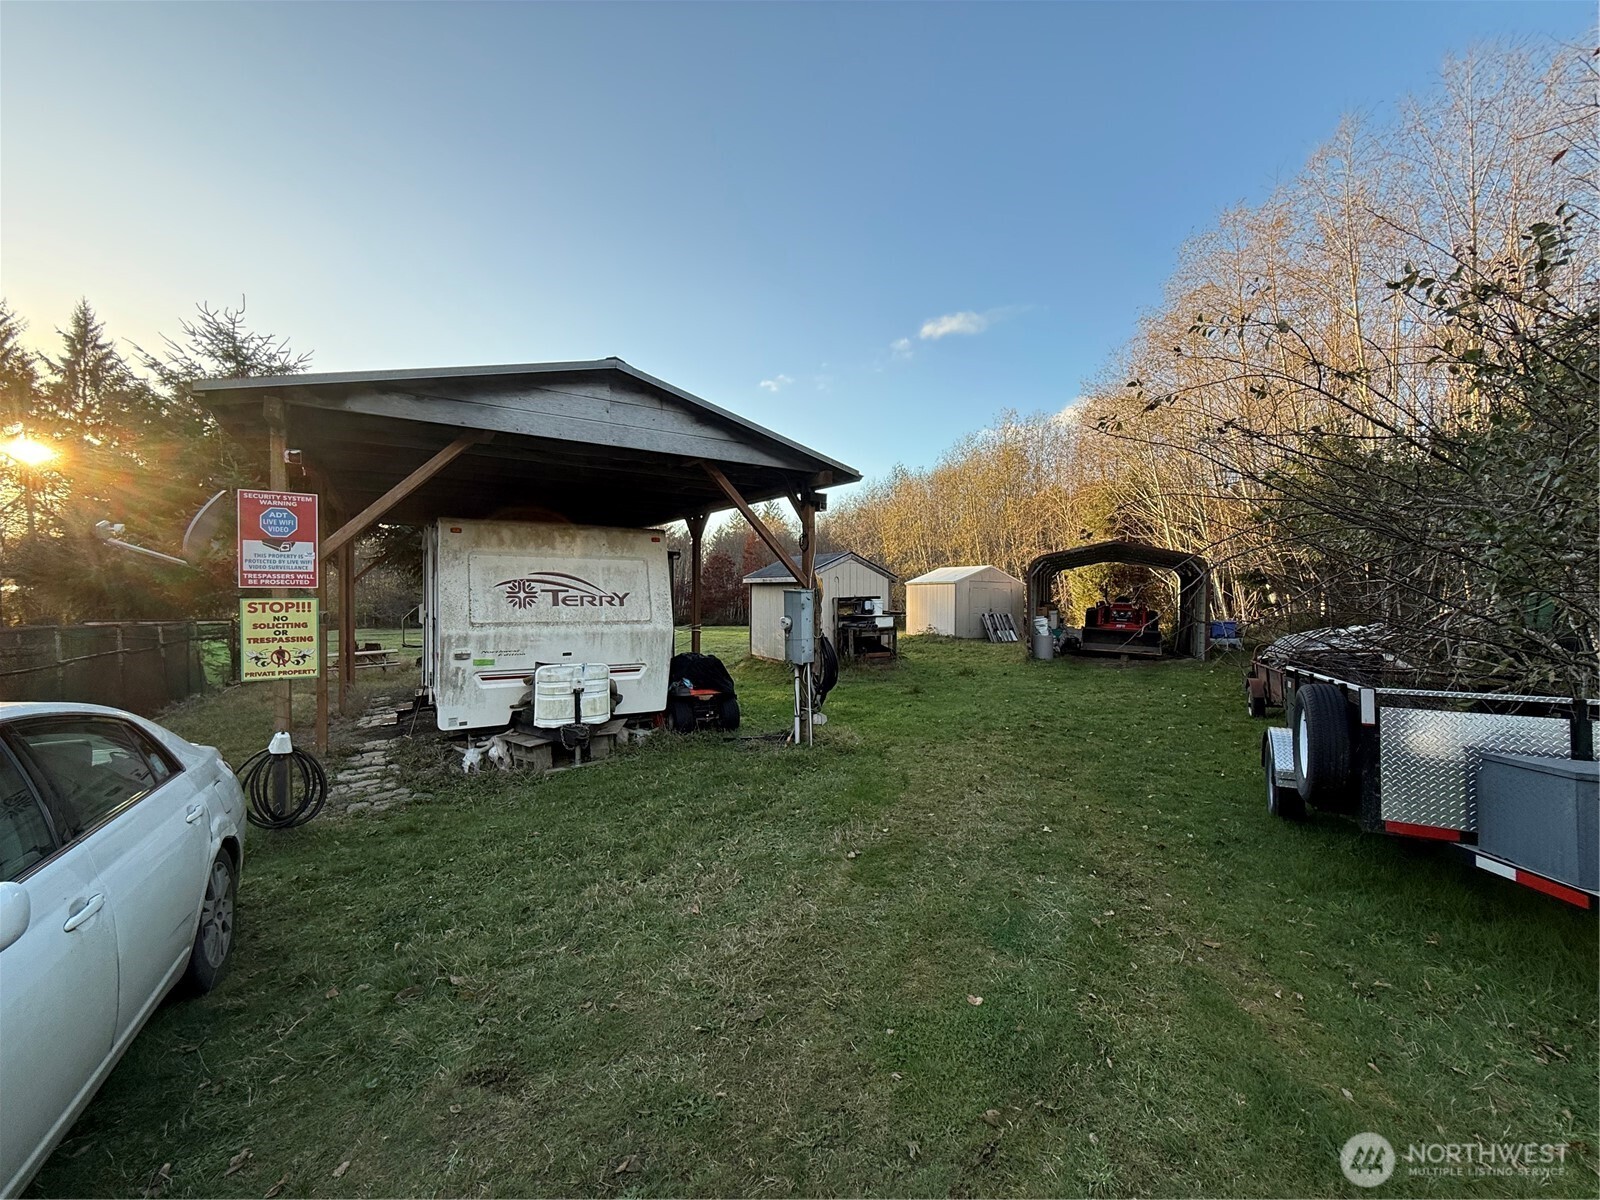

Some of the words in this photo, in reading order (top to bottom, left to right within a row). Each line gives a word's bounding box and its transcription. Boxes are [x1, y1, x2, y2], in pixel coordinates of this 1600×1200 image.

[540, 589, 630, 607] TERRY
[248, 602, 312, 613] STOP!!!
[252, 622, 308, 630] SOLICITING
[246, 636, 314, 644] TRESPASSING
